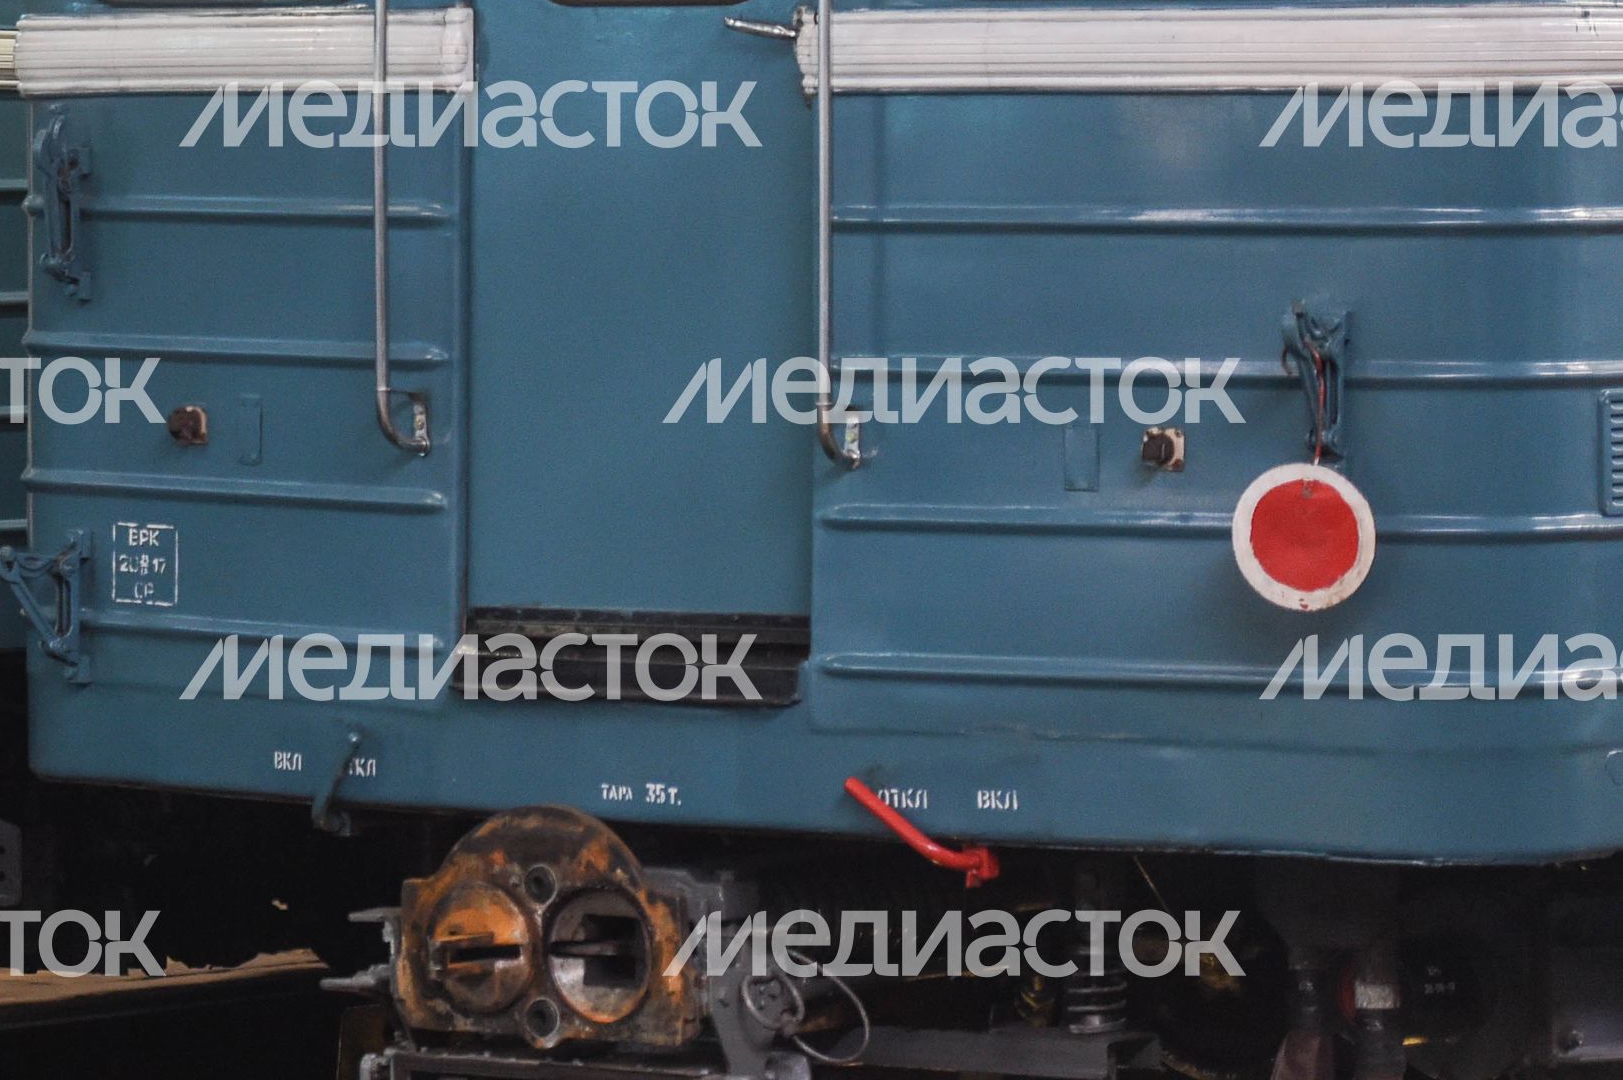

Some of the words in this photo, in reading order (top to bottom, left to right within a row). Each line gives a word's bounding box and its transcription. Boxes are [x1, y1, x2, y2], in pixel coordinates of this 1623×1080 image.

[274, 750, 302, 772] ВКЛ
[601, 783, 633, 801] ТАРА
[977, 789, 1018, 811] ВКЛ
